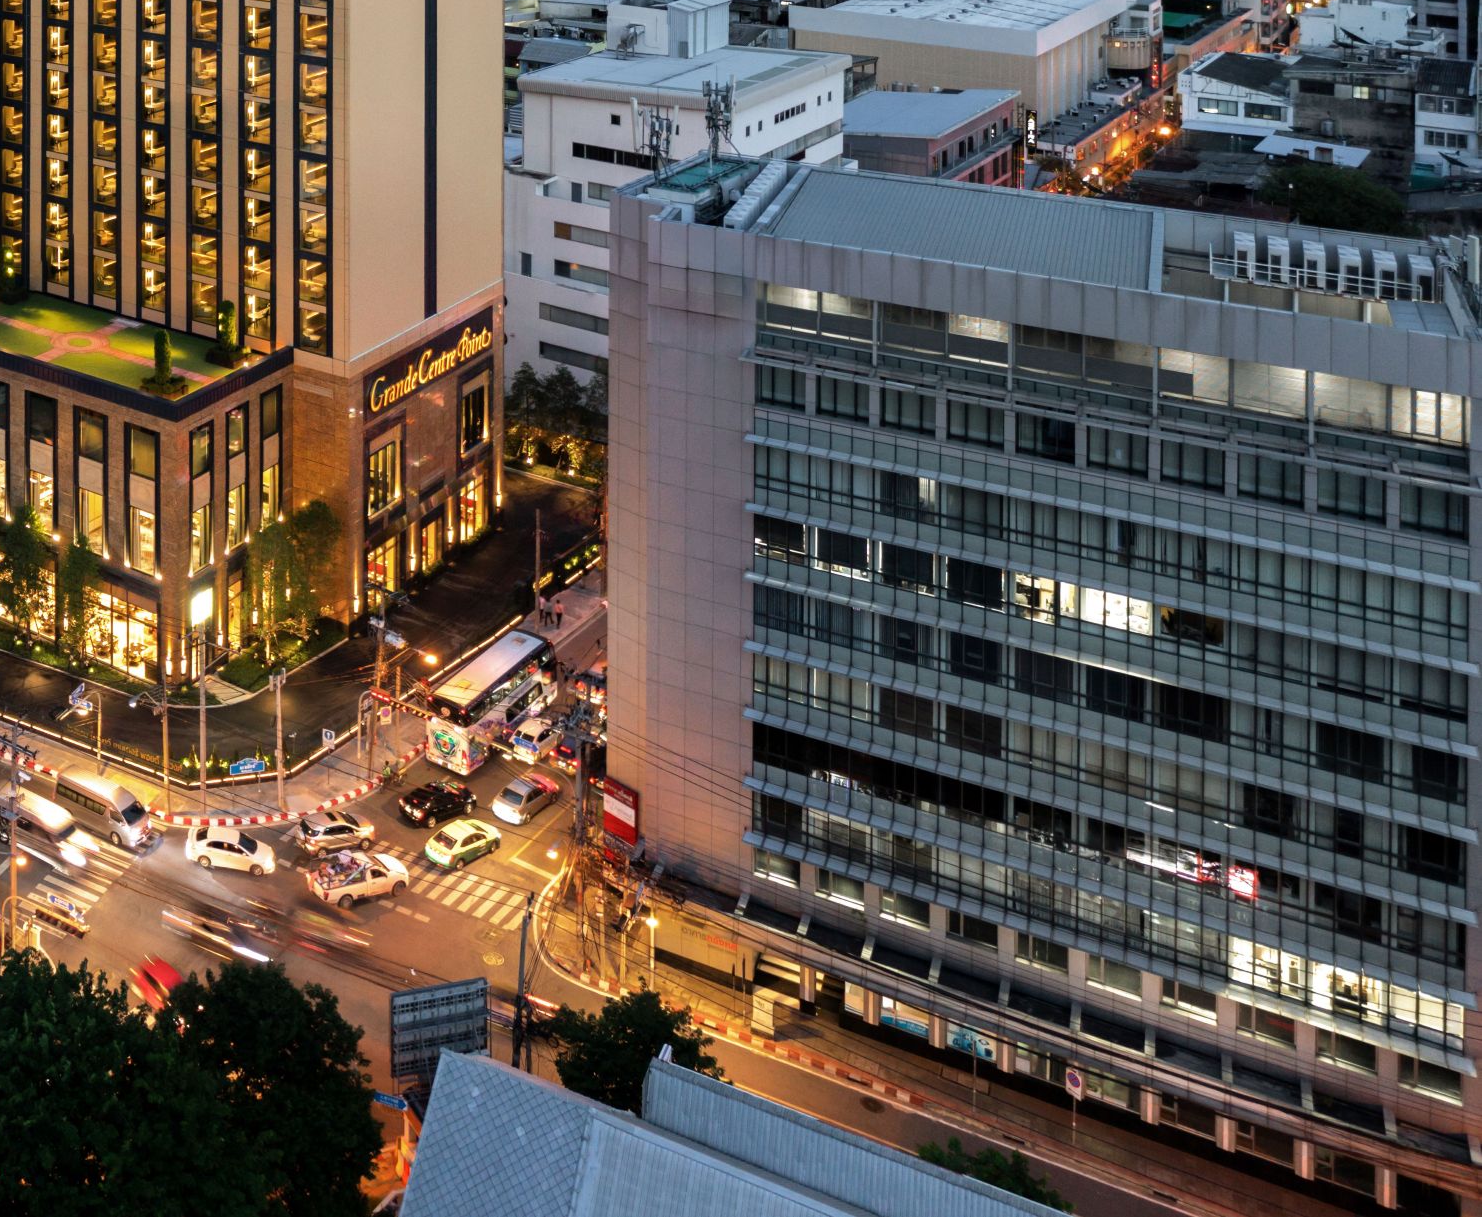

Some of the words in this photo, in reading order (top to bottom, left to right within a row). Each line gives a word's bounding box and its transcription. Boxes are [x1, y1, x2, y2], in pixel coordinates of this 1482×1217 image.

[370, 364, 418, 412] Grande
[418, 348, 457, 384] Centre
[457, 326, 492, 362] Point
